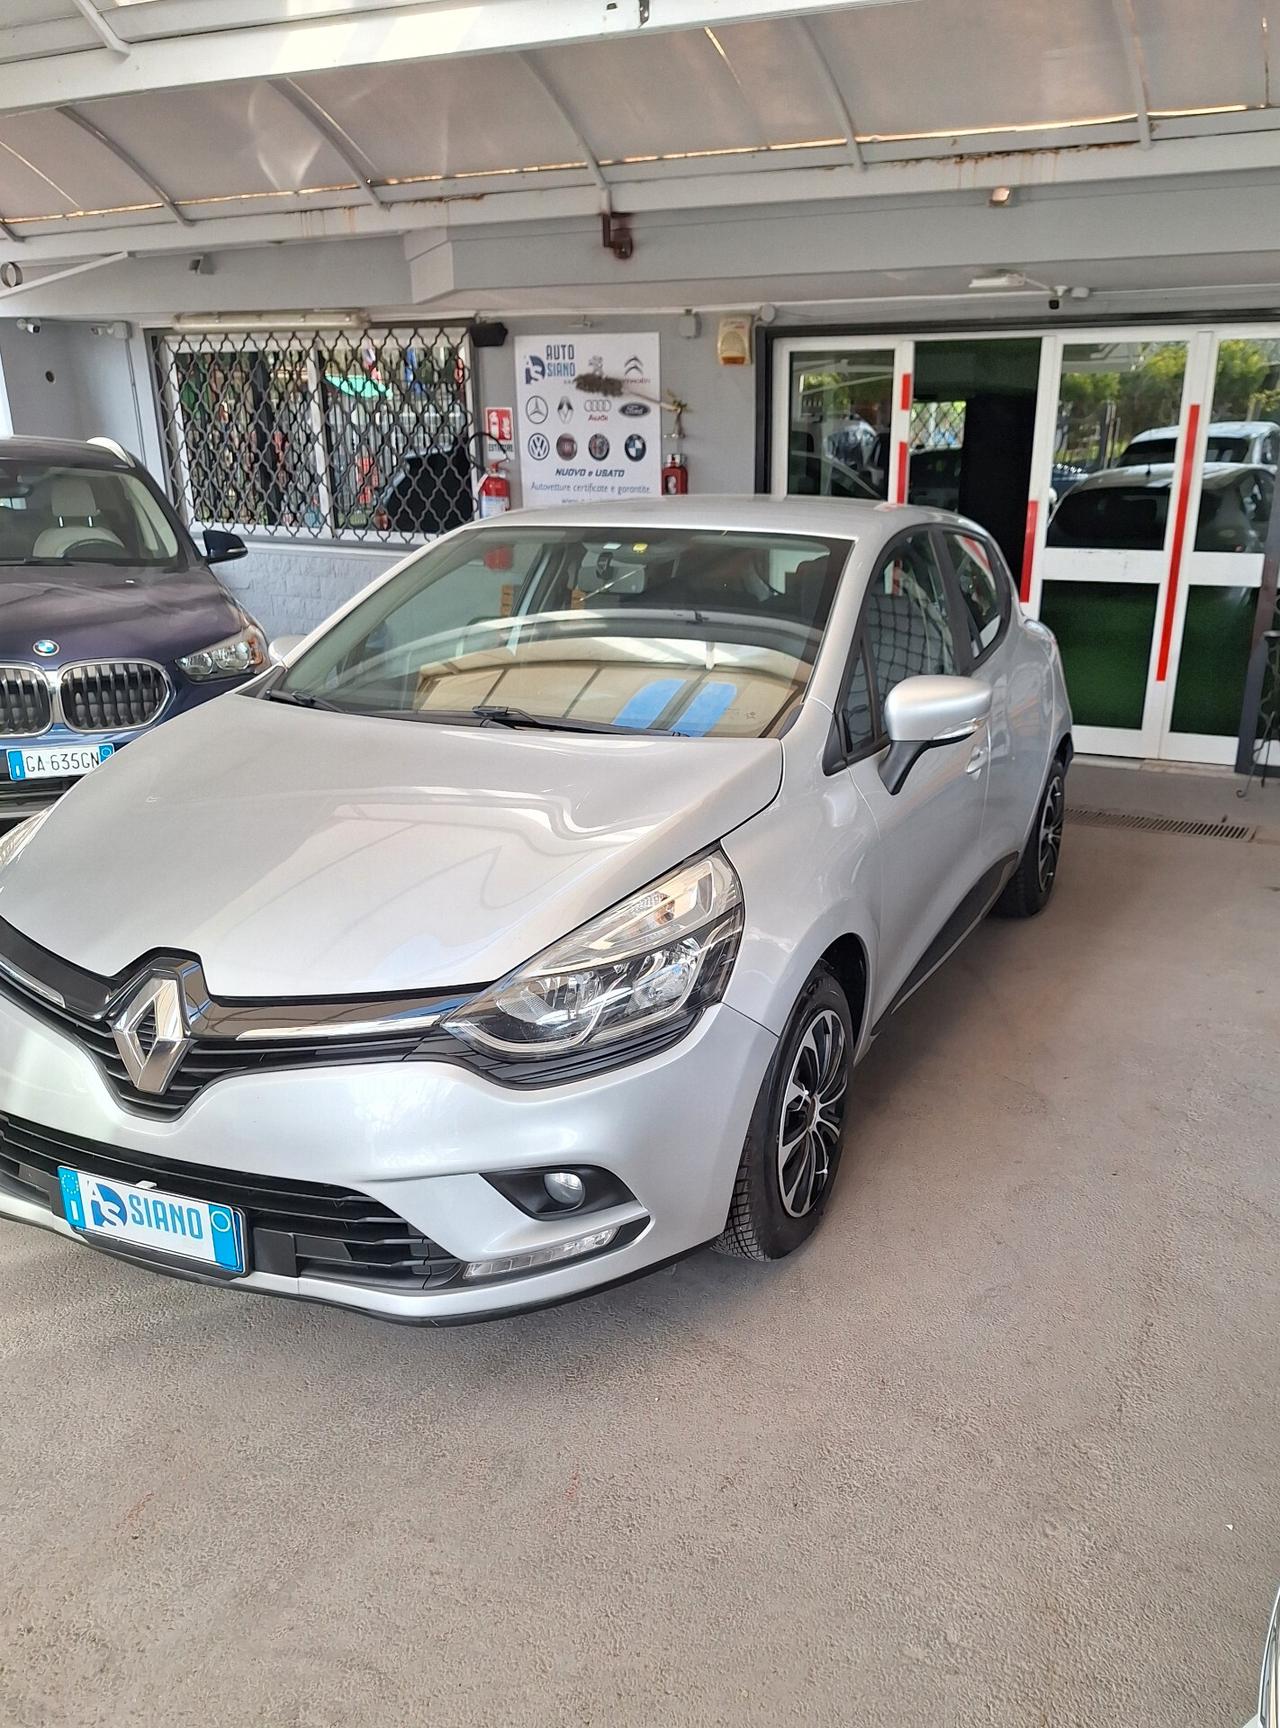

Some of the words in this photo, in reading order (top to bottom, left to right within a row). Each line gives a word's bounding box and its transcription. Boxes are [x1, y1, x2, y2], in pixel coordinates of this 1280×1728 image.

[546, 344, 575, 360] AUTO
[547, 361, 576, 377] SIANO
[555, 468, 586, 477] NUOVO
[595, 469, 625, 478] USATO
[25, 756, 46, 772] GA
[50, 752, 100, 770] 635GN
[128, 1193, 204, 1240] SIANO
